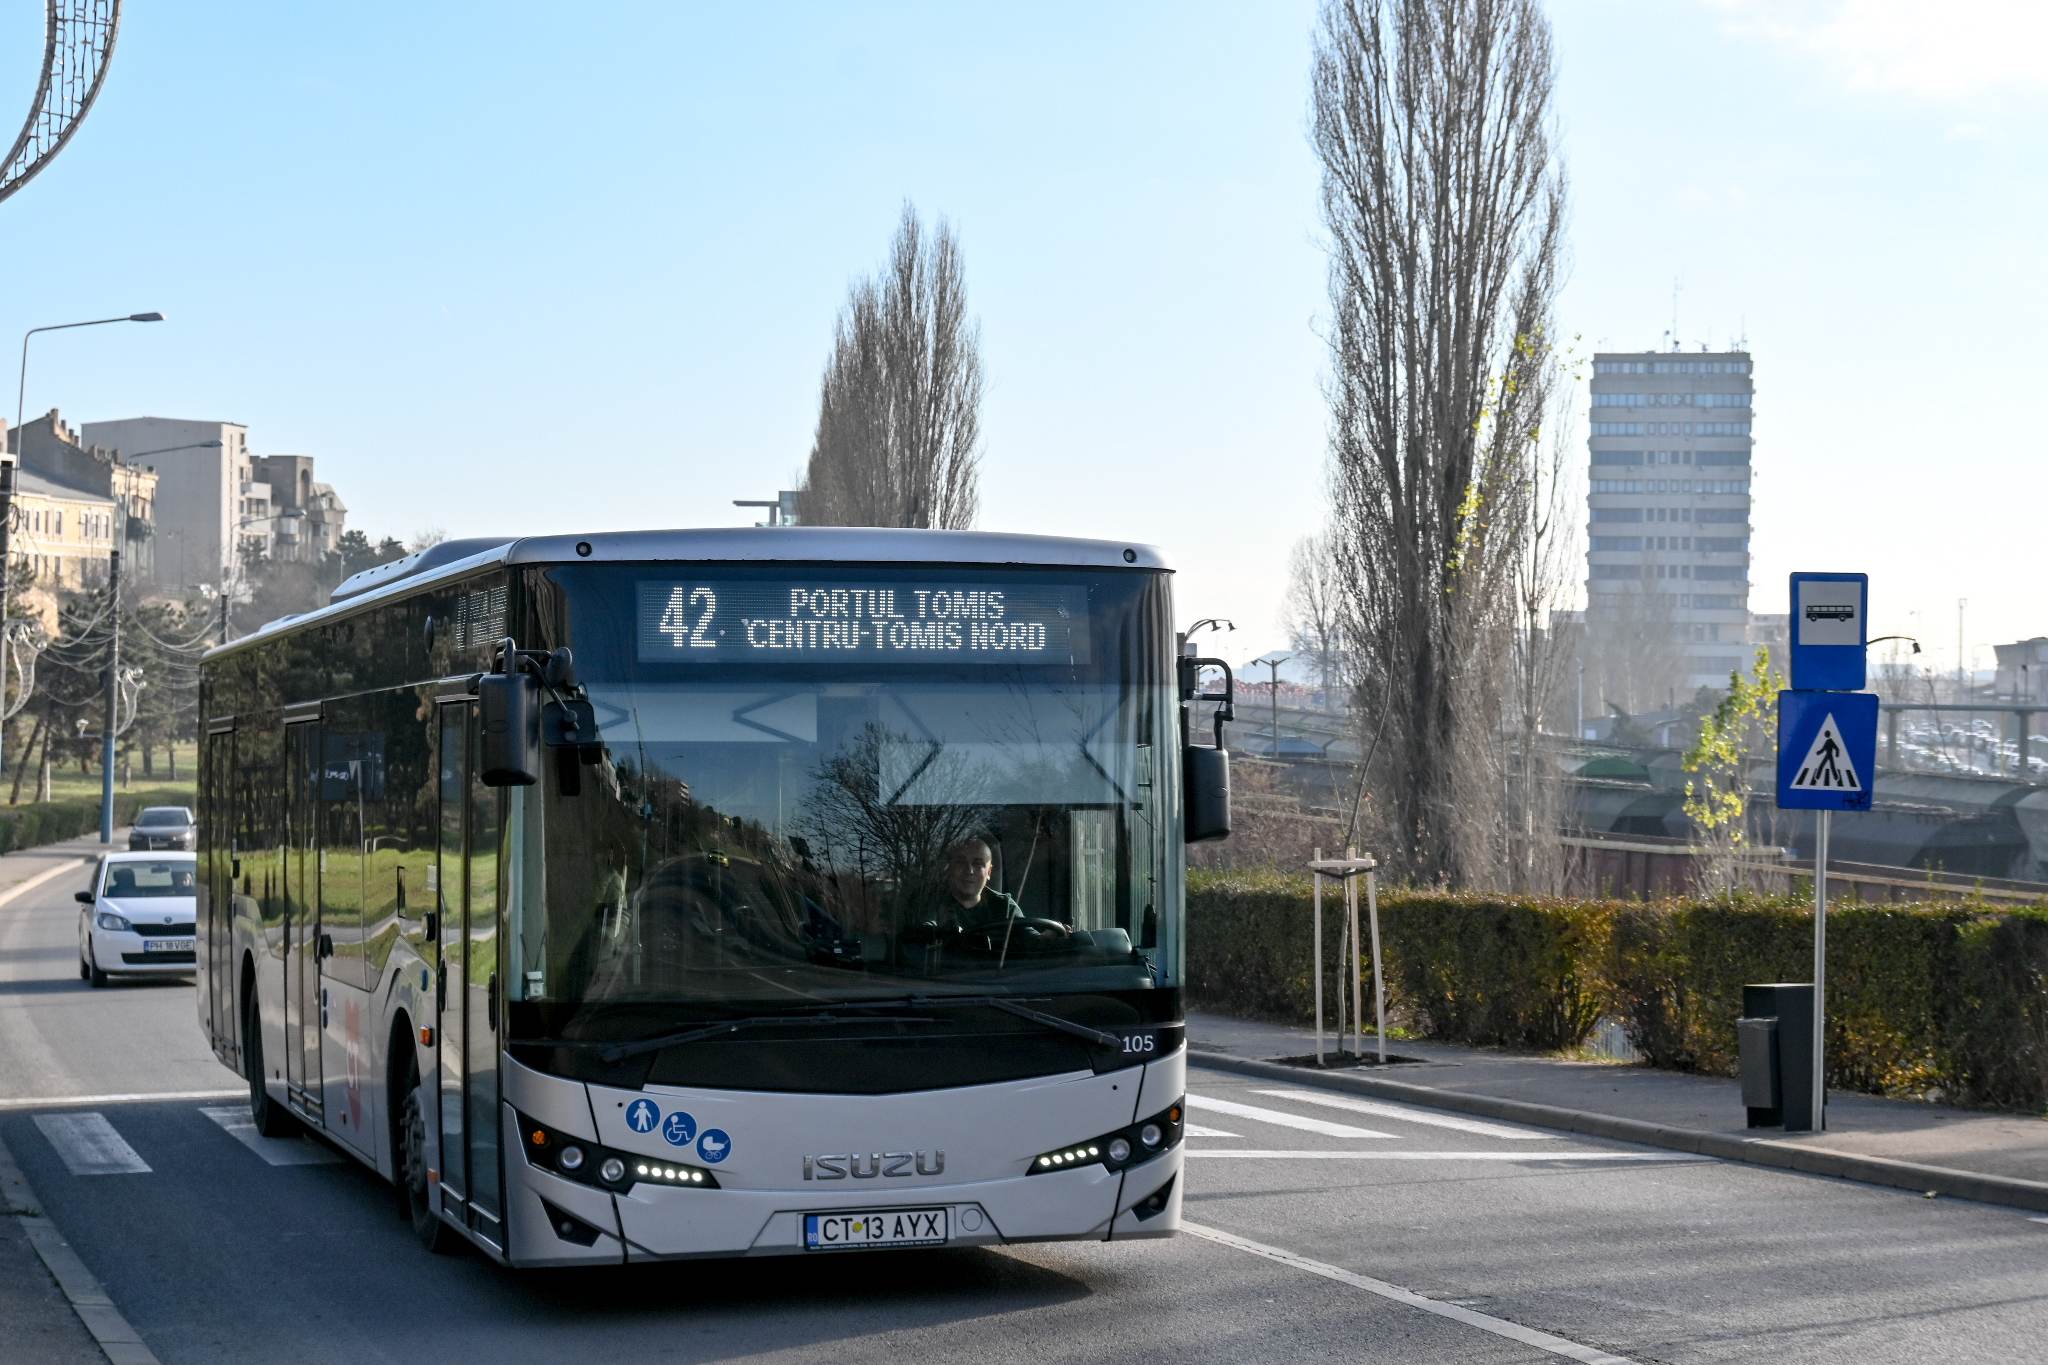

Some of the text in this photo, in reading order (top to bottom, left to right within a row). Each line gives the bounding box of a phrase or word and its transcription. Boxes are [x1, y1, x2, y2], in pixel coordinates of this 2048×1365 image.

[659, 586, 716, 648] 42
[789, 588, 1005, 619] PORTUL TOMIS
[746, 618, 1047, 650] CENTRU-TOMIS NORD
[1122, 1035, 1154, 1053] 105
[803, 1149, 945, 1181] ISUZU
[823, 1213, 939, 1242] CT 13 AYX
